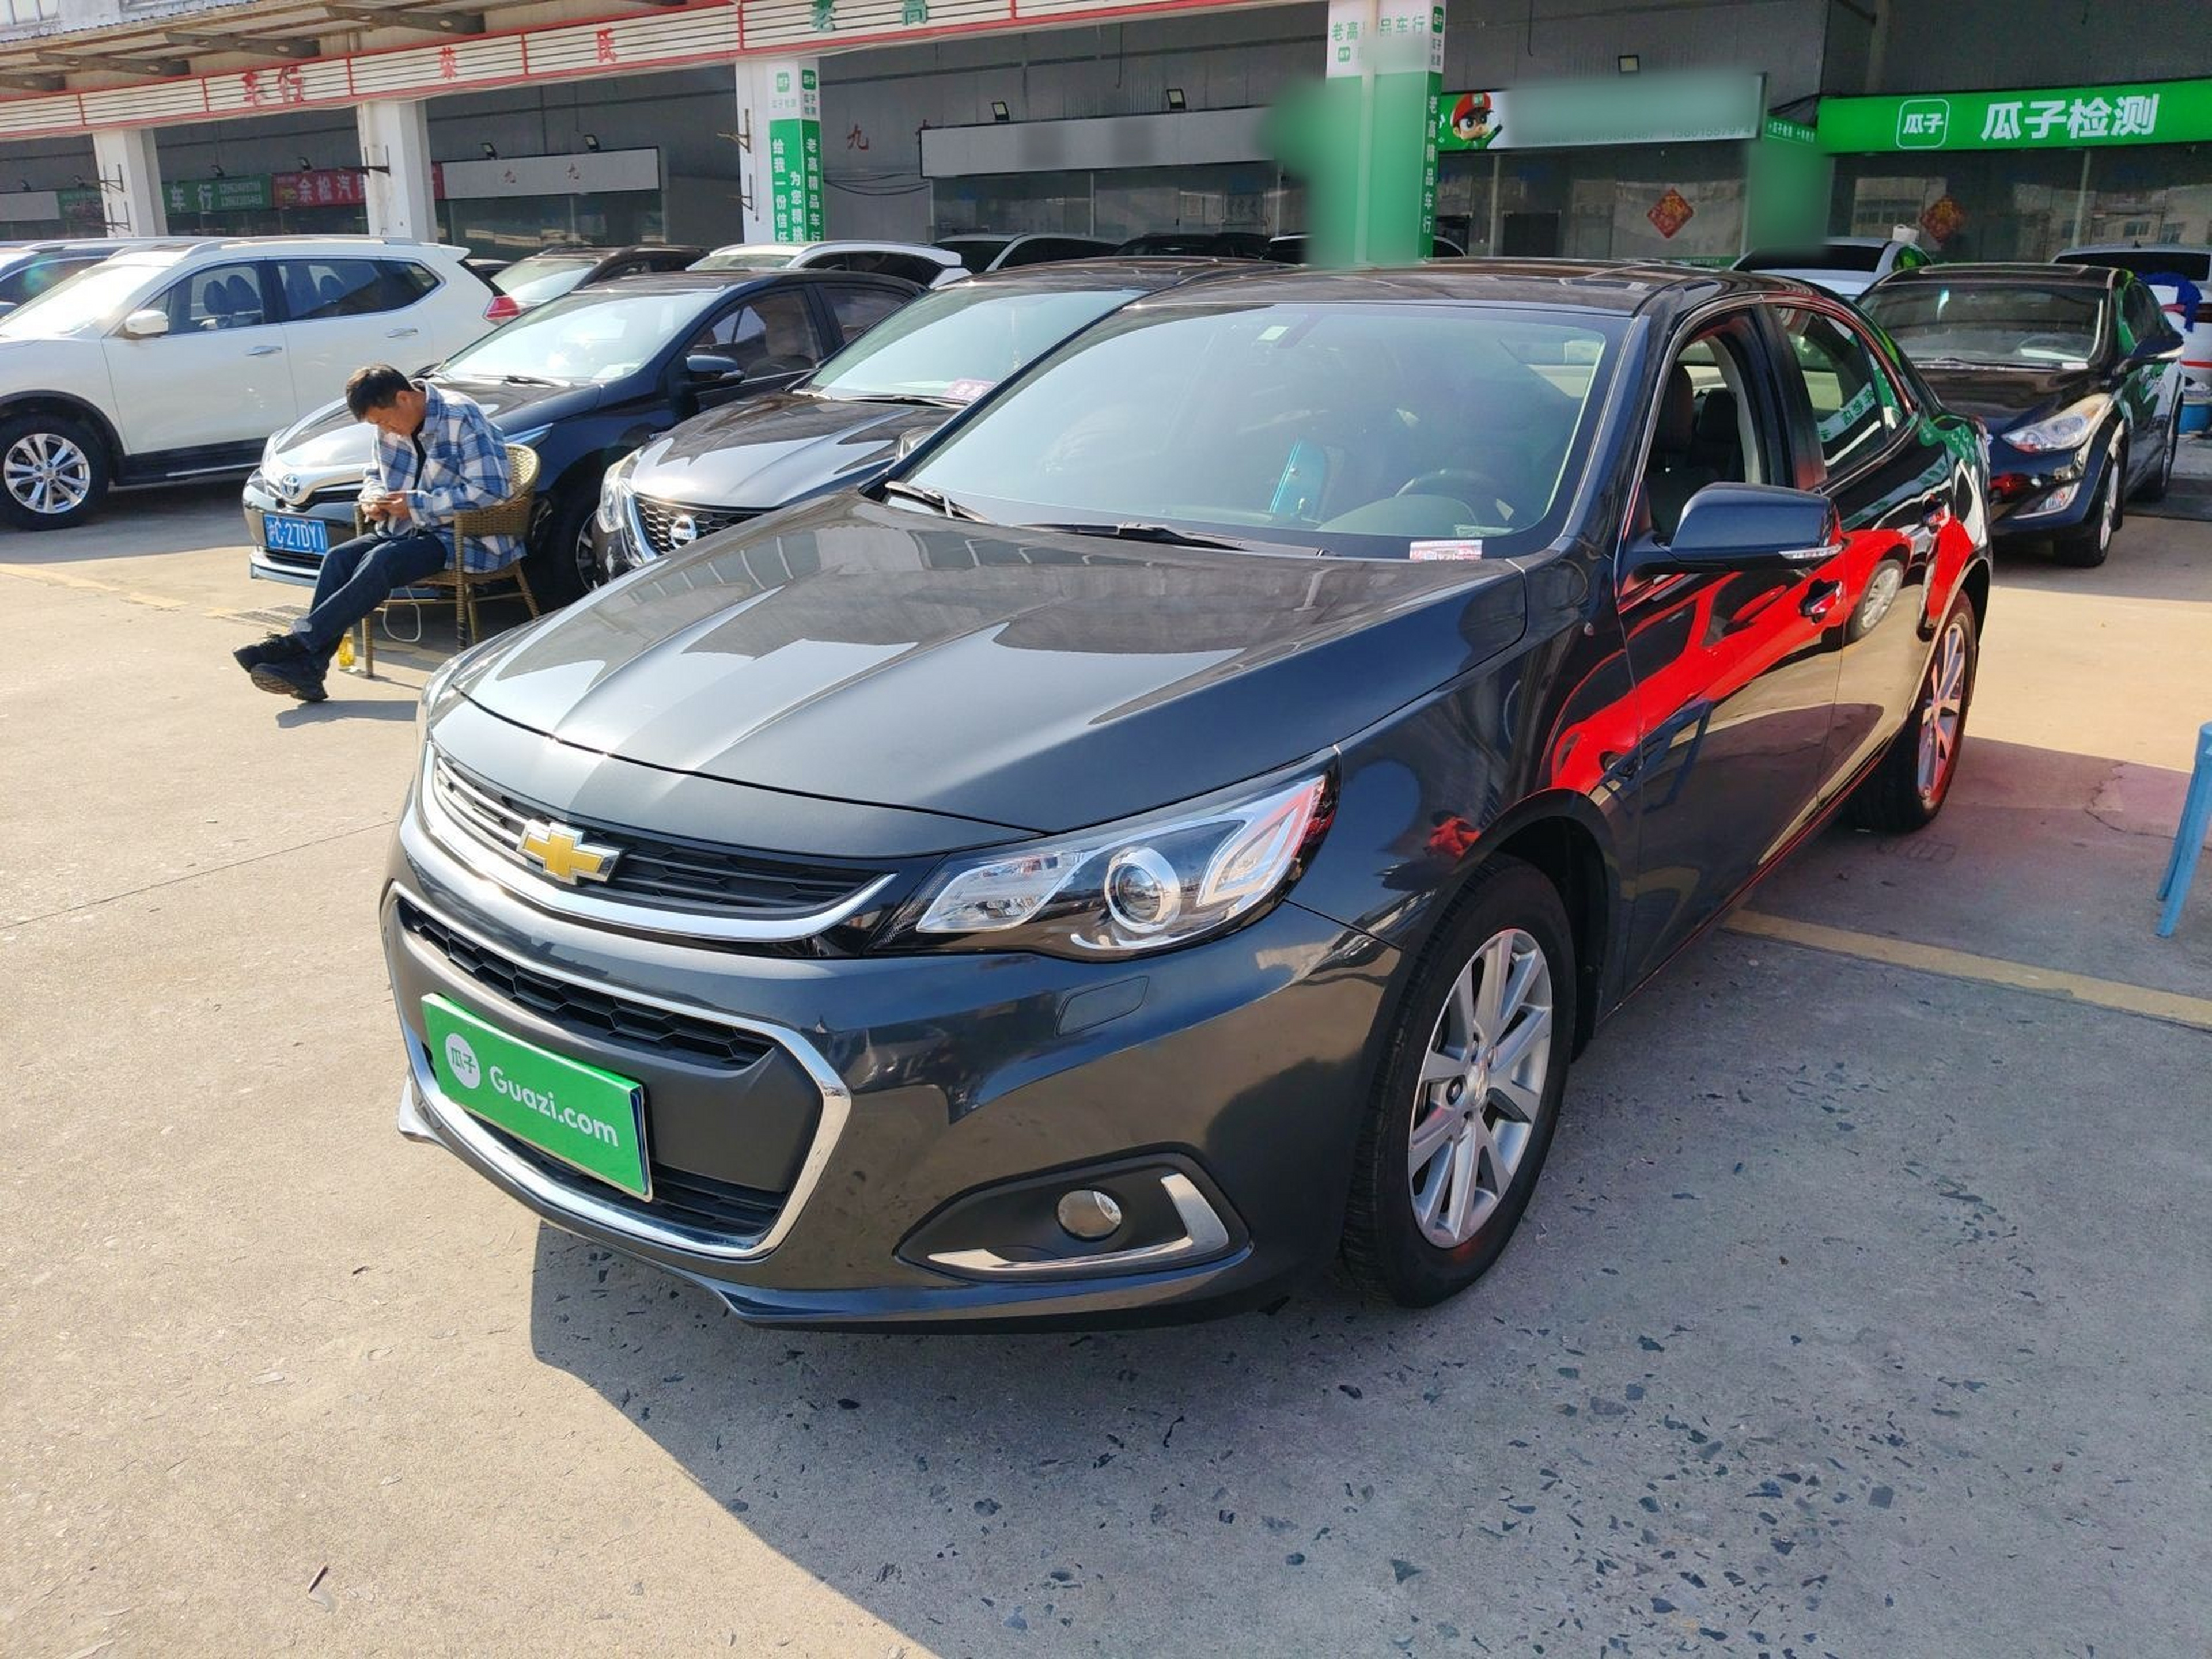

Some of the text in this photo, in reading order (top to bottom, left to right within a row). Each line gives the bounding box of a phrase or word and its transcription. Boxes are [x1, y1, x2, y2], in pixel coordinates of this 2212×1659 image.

[1332, 16, 1425, 41] 老高品车行
[1903, 113, 1944, 134] 瓜子
[1980, 93, 2160, 141] 瓜子检测
[451, 1047, 476, 1074] 瓜子
[490, 1066, 619, 1147] Guazi.com
